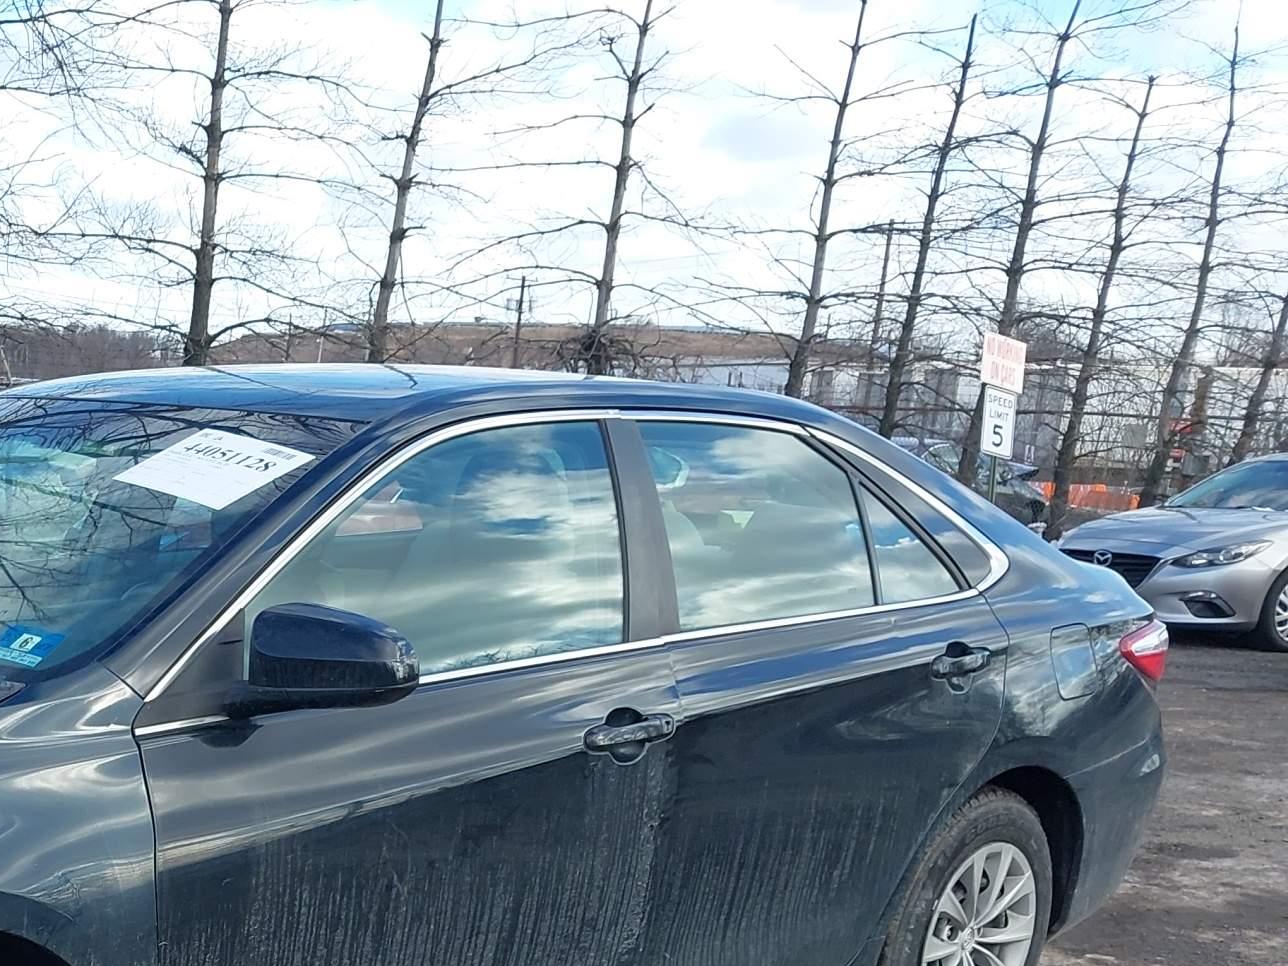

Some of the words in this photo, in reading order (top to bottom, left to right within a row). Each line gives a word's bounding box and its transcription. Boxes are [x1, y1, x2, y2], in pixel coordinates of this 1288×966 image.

[987, 393, 1014, 409] SPEED
[989, 408, 1010, 422] LIMIT
[991, 424, 1004, 448] 5
[183, 442, 278, 473] 44051128
